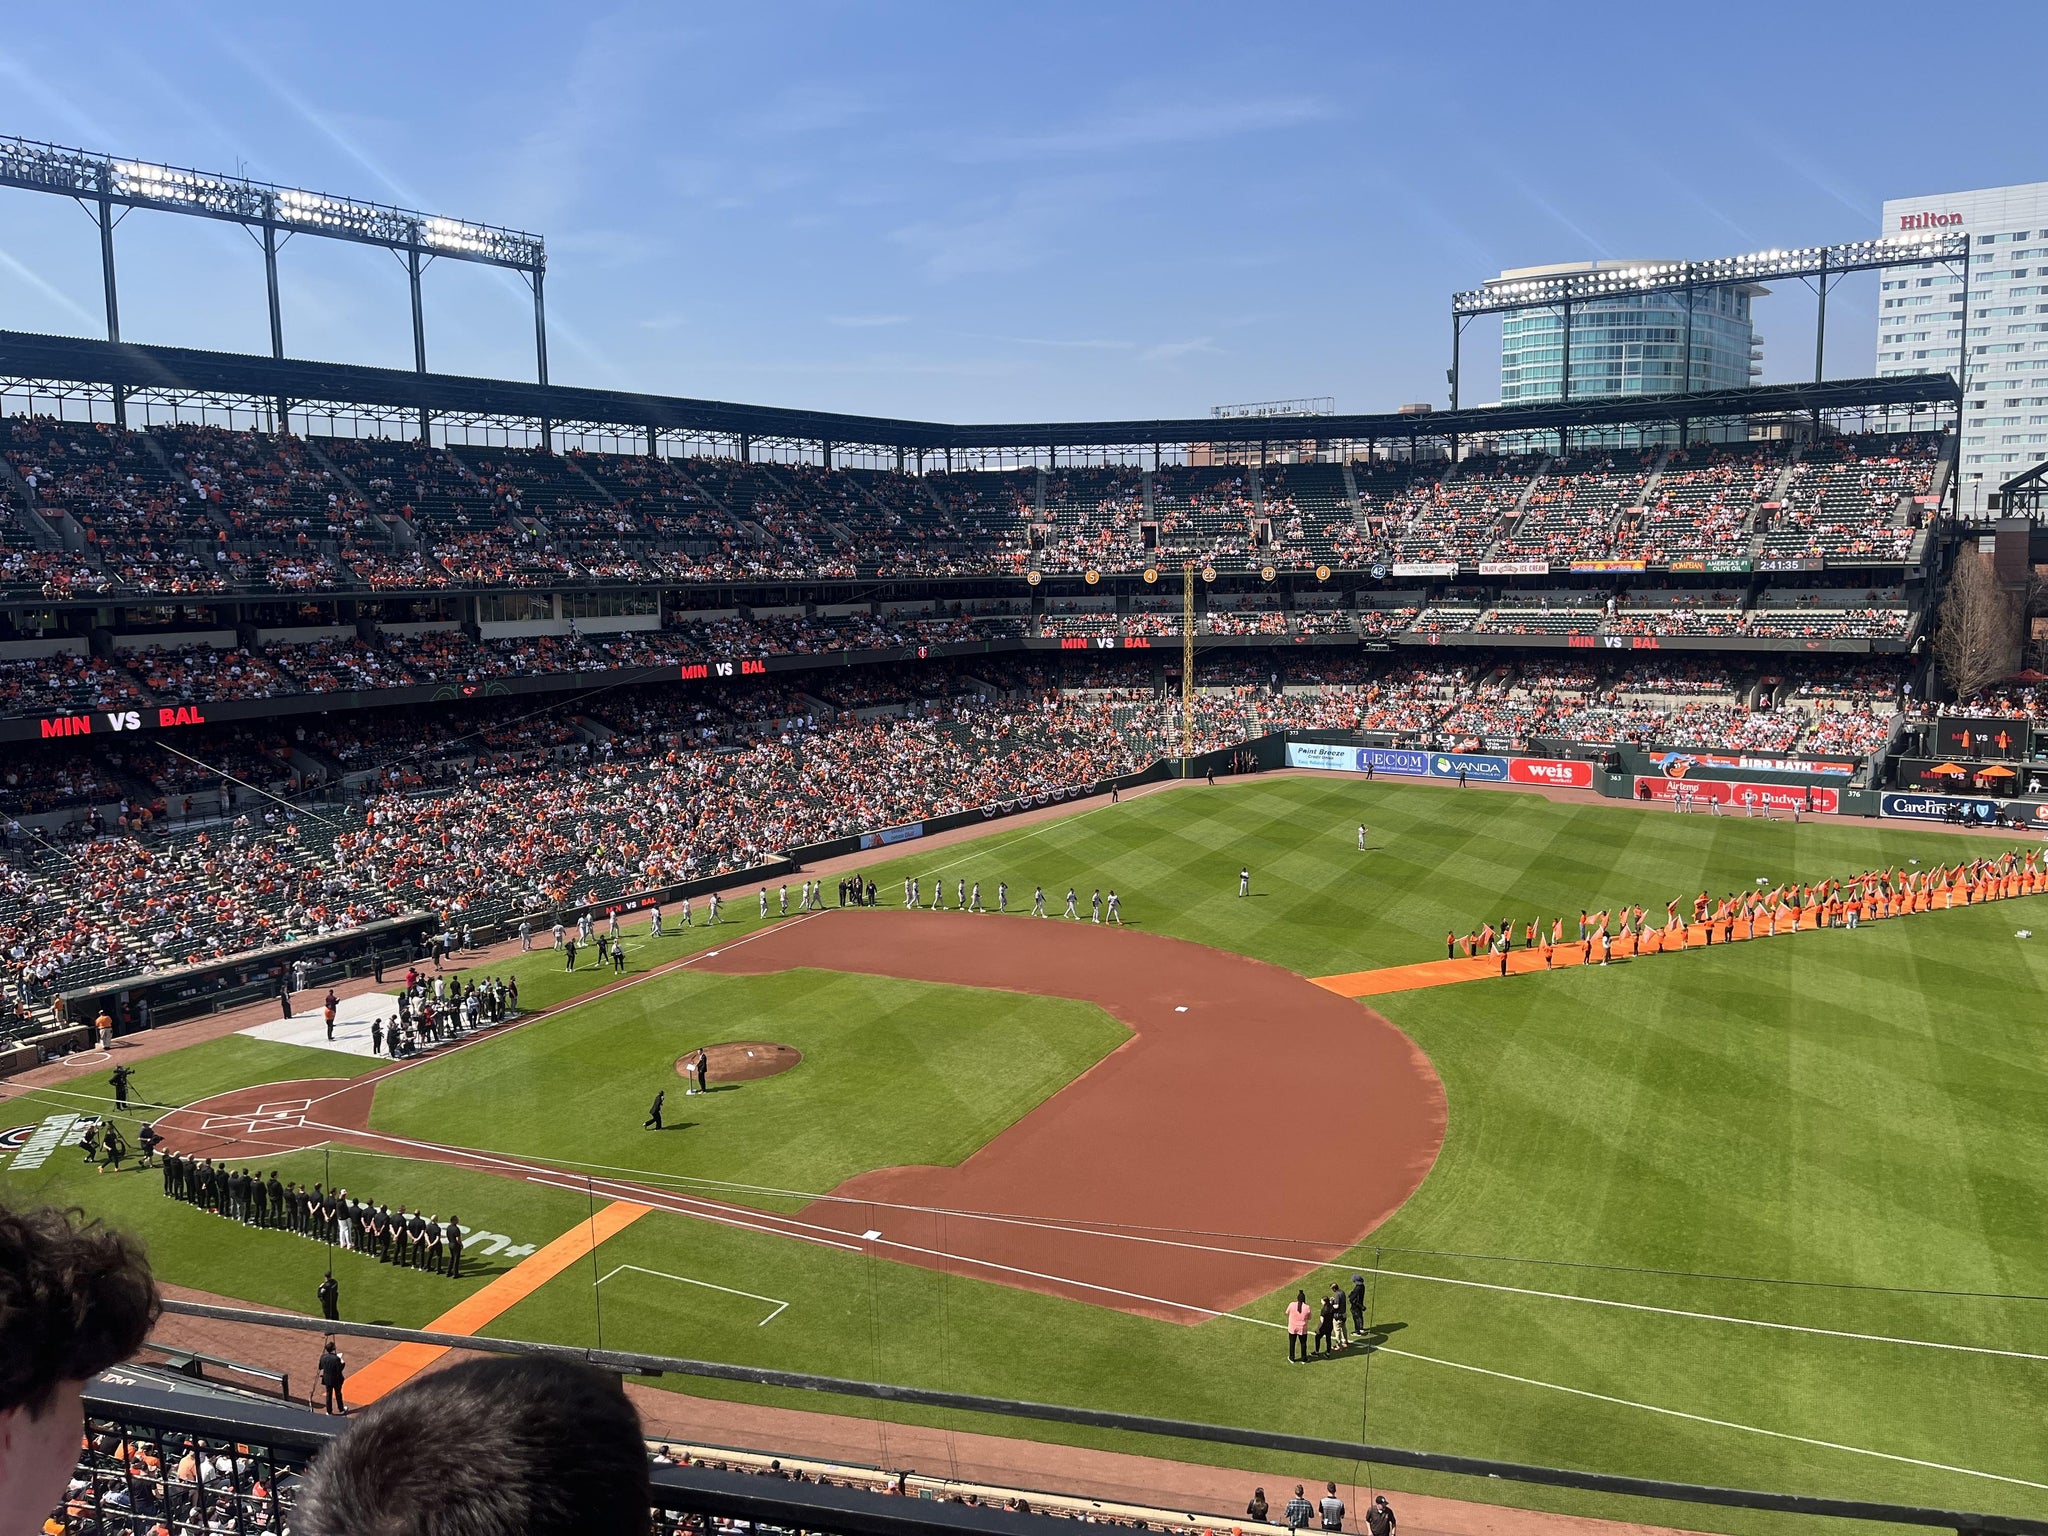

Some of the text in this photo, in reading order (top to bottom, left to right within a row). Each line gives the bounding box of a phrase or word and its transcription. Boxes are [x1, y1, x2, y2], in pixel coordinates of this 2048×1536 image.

[1900, 211, 1963, 230] Hilton
[1373, 567, 1383, 575] 42
[1760, 560, 1798, 570] 2:41:35
[1030, 574, 1039, 582] 20
[1062, 637, 1150, 648] MIN VS BAL
[1568, 636, 1660, 648] MIN VS BAL
[682, 660, 766, 679] MIN VS BAL
[40, 706, 204, 738] MIN VS BAL
[1362, 752, 1422, 767] LECOM
[1740, 758, 1811, 771] BIRD BATH
[1452, 761, 1500, 773] VANDA
[1528, 764, 1572, 778] weis
[1666, 781, 1699, 792] Airtemp
[642, 897, 656, 906] BAL
